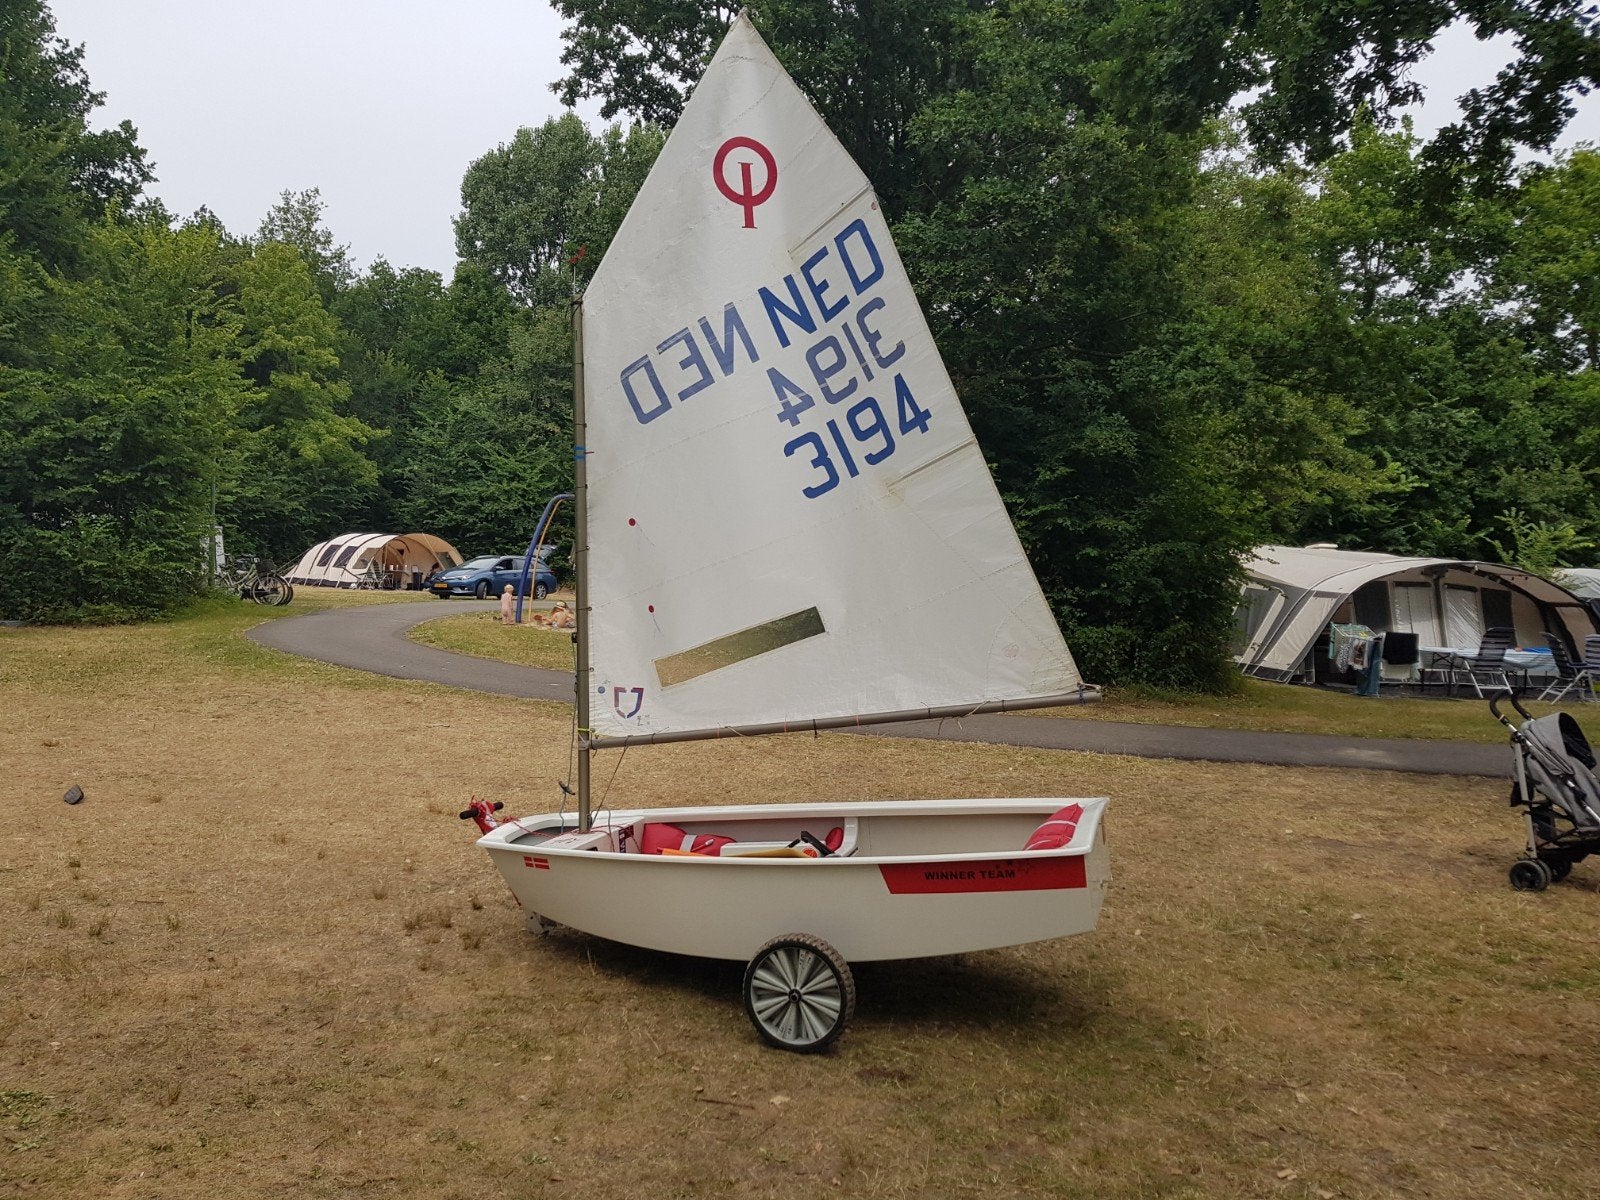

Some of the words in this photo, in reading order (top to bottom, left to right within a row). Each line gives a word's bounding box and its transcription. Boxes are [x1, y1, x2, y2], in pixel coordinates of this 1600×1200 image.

[757, 218, 885, 349] NED
[783, 372, 933, 500] 3194
[924, 870, 976, 880] WINNER
[980, 869, 1016, 879] TEAM
